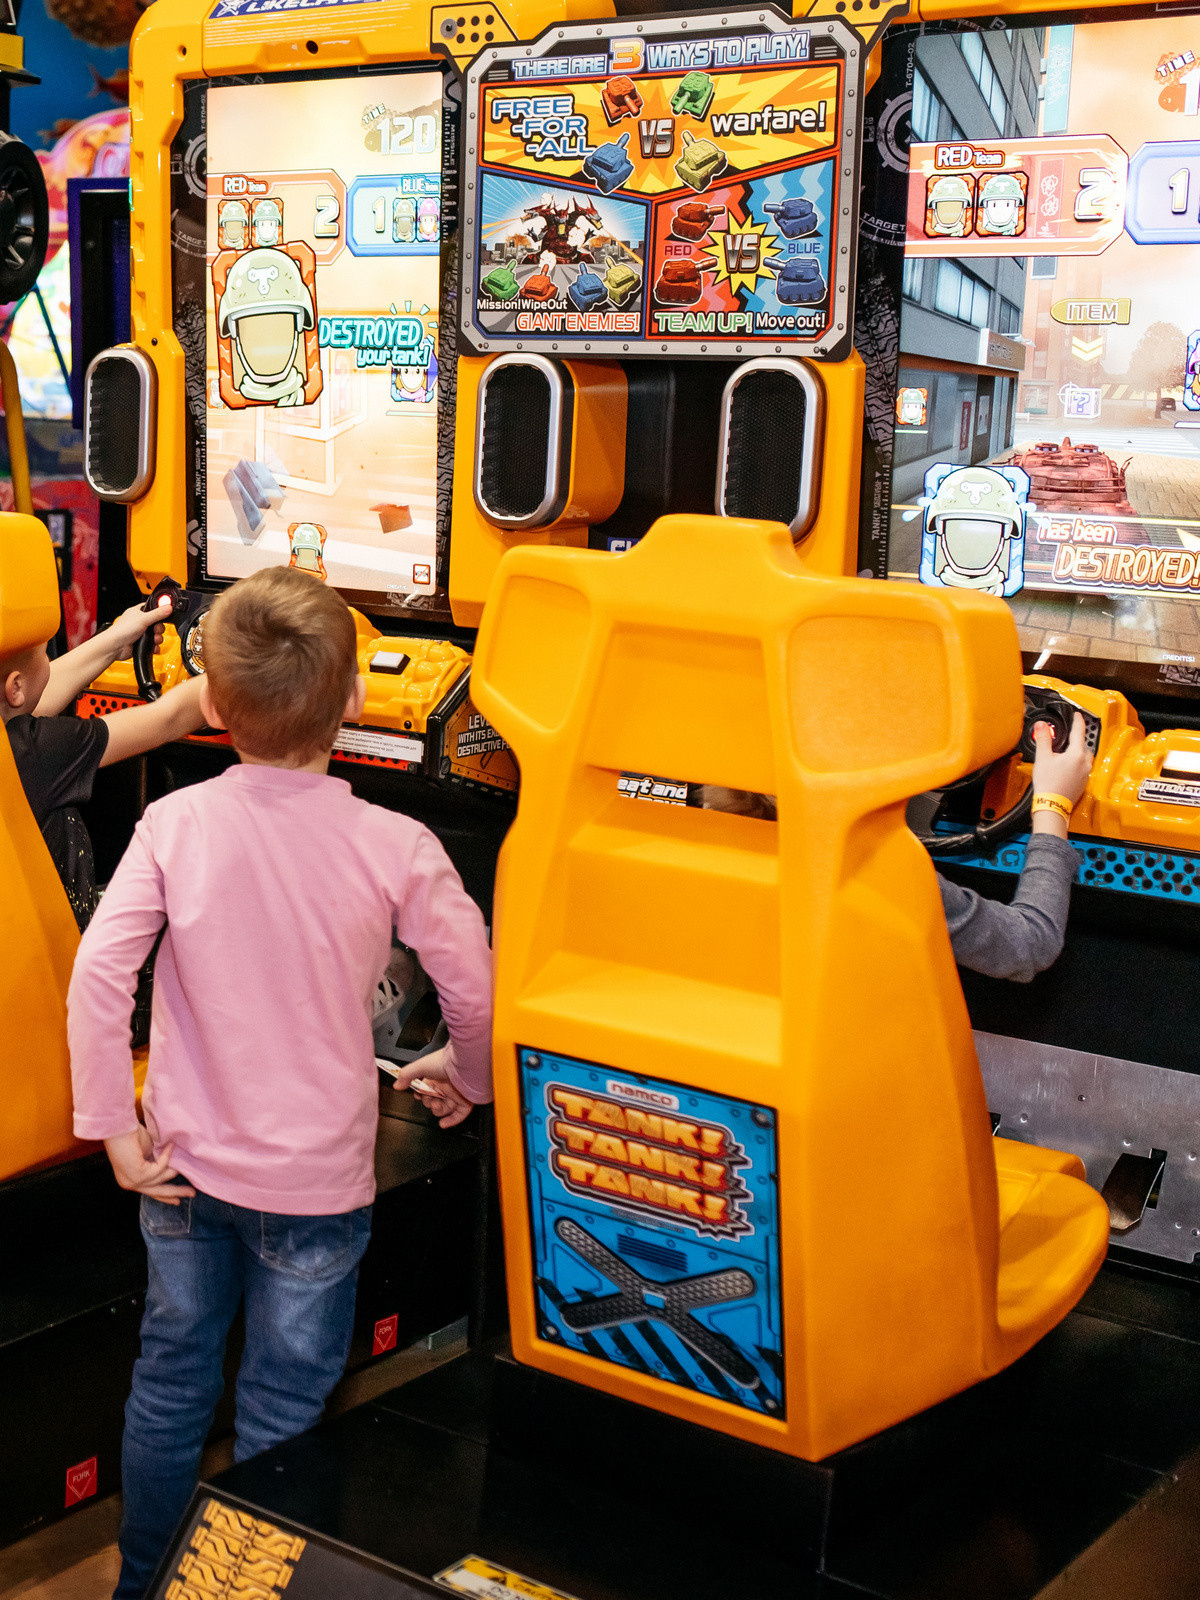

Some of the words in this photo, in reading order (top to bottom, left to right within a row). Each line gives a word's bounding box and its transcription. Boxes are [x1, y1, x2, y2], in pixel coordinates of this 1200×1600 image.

[514, 57, 567, 79] THERE
[571, 55, 606, 75] ARE
[611, 38, 645, 72] 3
[649, 43, 711, 69] WAYS
[712, 41, 738, 64] TO
[743, 33, 809, 62] PLAY!
[1156, 50, 1196, 78] TIME
[363, 103, 387, 125] TIME
[493, 98, 573, 119] FREE
[711, 102, 827, 134] warfare!
[377, 115, 437, 156] 120
[512, 116, 587, 136] -FOR
[526, 136, 598, 158] -ALL
[640, 119, 676, 158] VS
[937, 146, 973, 167] RED
[974, 151, 1004, 166] Team
[224, 177, 247, 194] RED
[402, 175, 425, 193] BLUE
[1075, 168, 1118, 222] 2
[1169, 168, 1190, 214] 1
[314, 196, 341, 238] 2
[372, 196, 387, 233] 1
[863, 212, 906, 231] TARGET
[664, 244, 692, 256] RED
[723, 233, 761, 274] VS
[787, 242, 822, 255] BLUE
[516, 313, 564, 331] GIANT
[565, 312, 641, 332] ENEMIES!
[655, 313, 718, 332] TEAM
[720, 312, 752, 332] UP!
[755, 313, 795, 329] Move
[796, 313, 826, 329] out!
[1066, 302, 1119, 321] ITEM
[318, 318, 422, 348] DESTROYED
[357, 348, 391, 367] your
[391, 345, 430, 367] tank!
[1072, 518, 1114, 543] been
[457, 731, 476, 745] WITH
[457, 738, 503, 758] DESTRUCTIVE
[617, 778, 652, 794] eat
[651, 784, 687, 799] and
[611, 1082, 673, 1107] namco
[552, 1089, 725, 1155] TANK!
[554, 1121, 726, 1188] TANK!
[557, 1153, 728, 1221] TANK!
